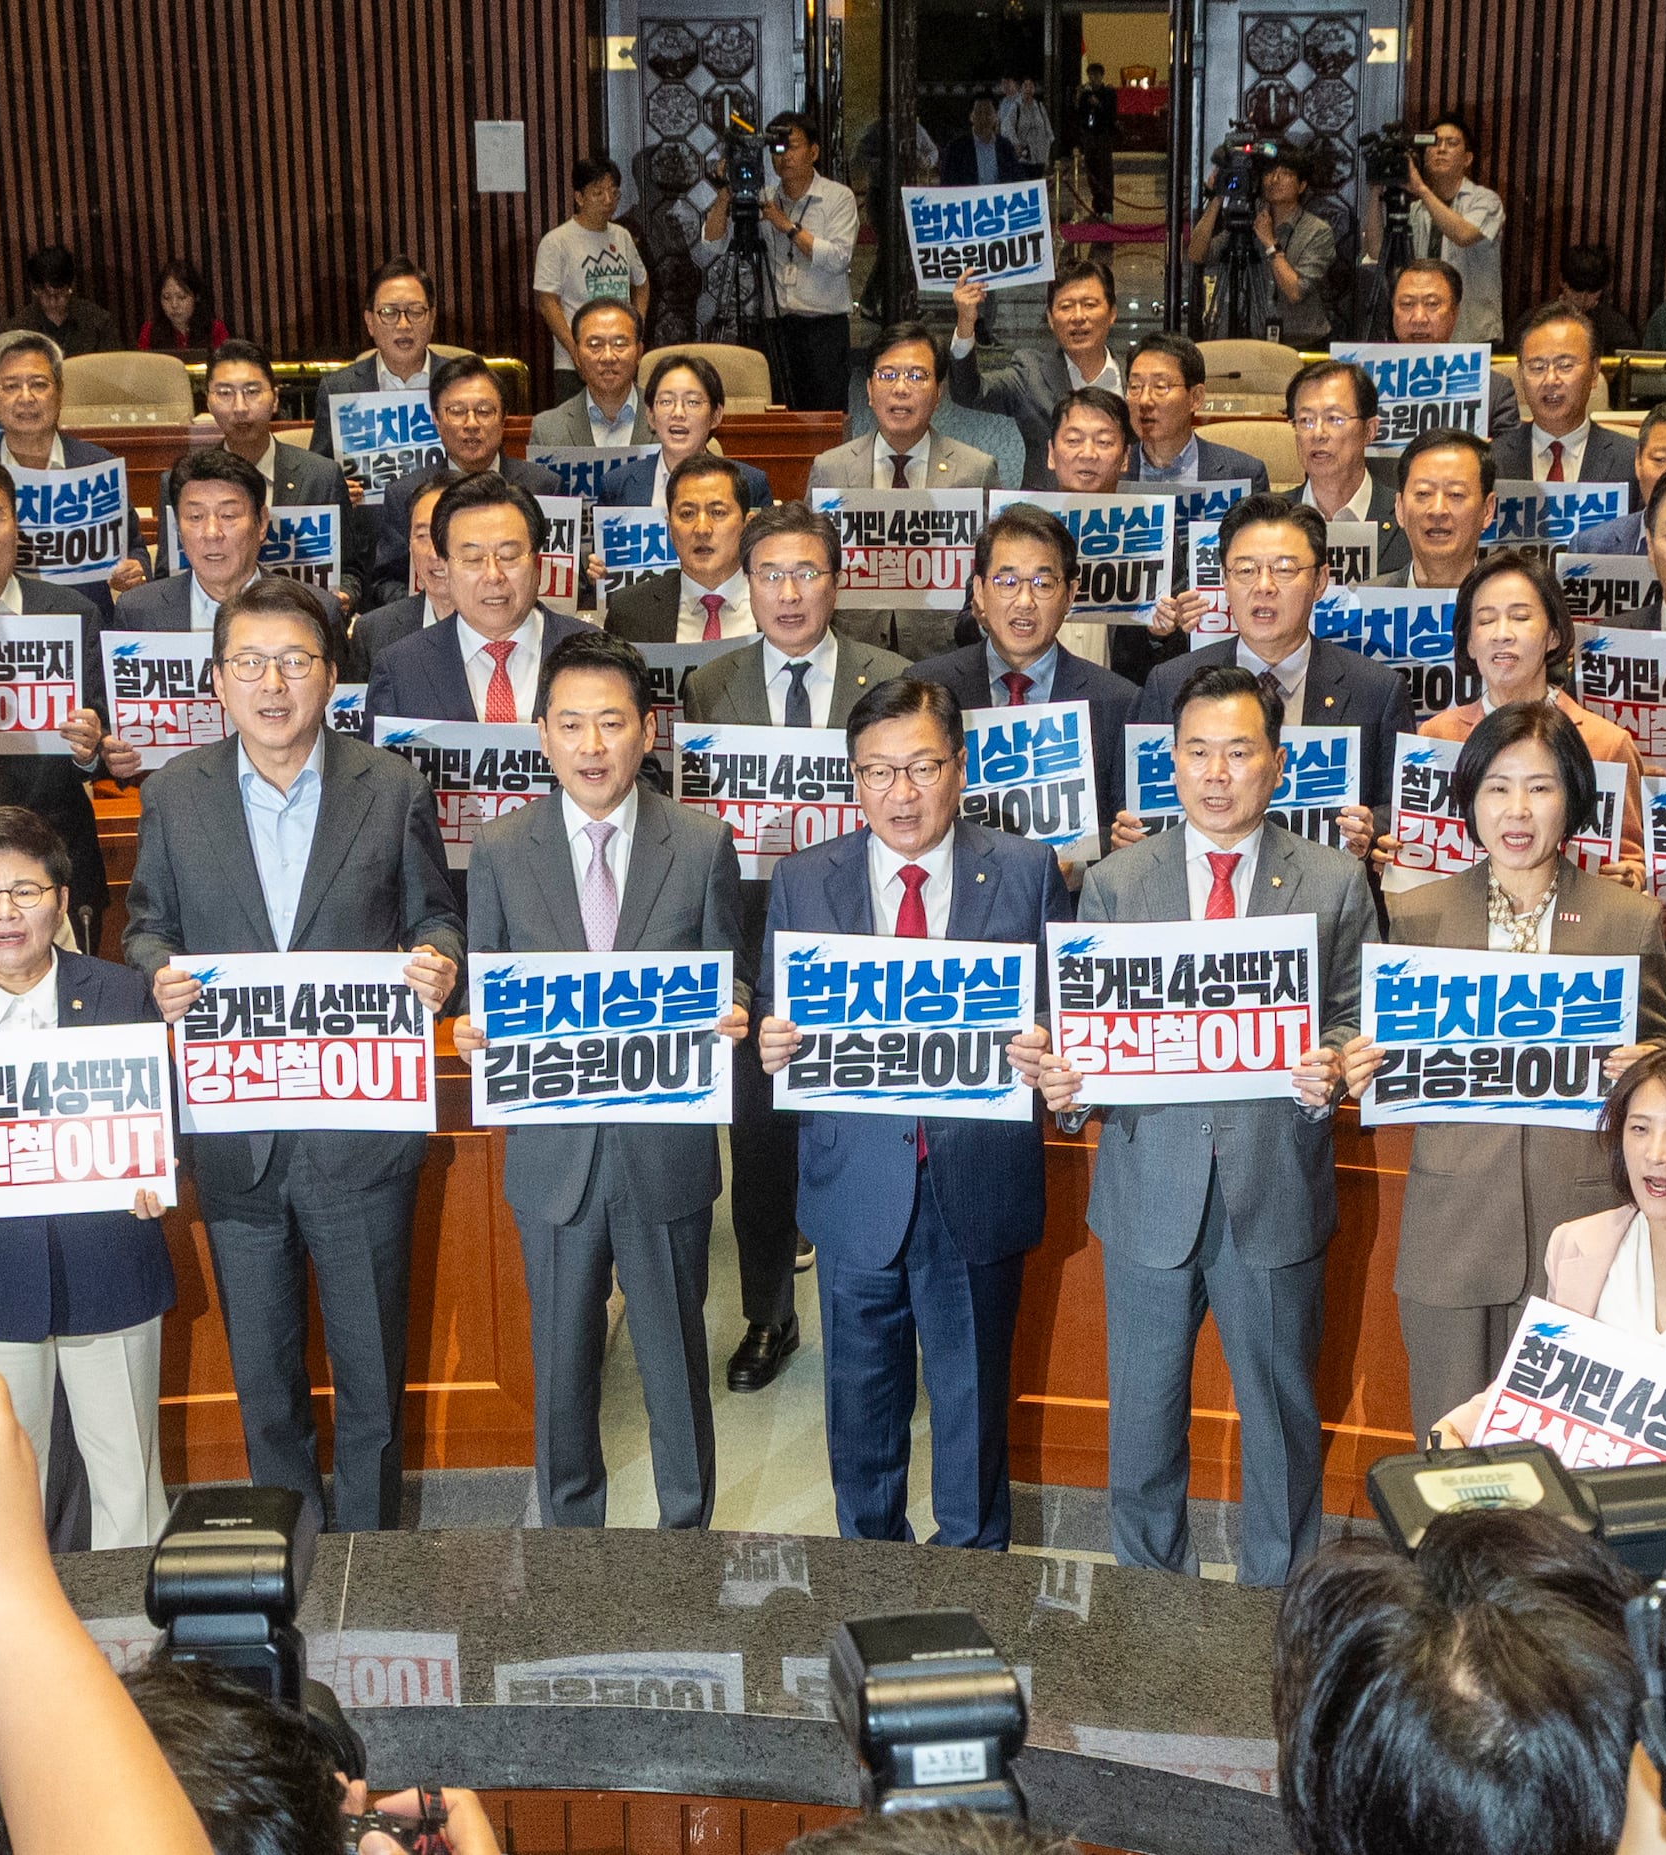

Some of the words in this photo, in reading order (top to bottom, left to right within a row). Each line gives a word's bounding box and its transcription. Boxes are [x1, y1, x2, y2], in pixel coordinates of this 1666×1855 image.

[912, 189, 1041, 244] 법치상실
[916, 231, 1044, 279] 김승원OUT
[339, 402, 439, 451] 법치상
[343, 450, 445, 497] 김승원O
[16, 481, 122, 526] 치상실
[835, 511, 886, 546] 거민
[888, 510, 977, 547] 4성딱지
[1066, 504, 1163, 555] 상실
[1175, 487, 1243, 527] 상실
[1488, 490, 1618, 545] 치상실
[17, 520, 123, 568] 승원OUT
[258, 515, 331, 566] 상실
[603, 524, 680, 568] 법치
[1078, 560, 1163, 602] OUT
[1314, 604, 1454, 660] 법치상
[113, 657, 196, 700] 철거민
[1581, 655, 1659, 702] 철거민
[115, 701, 226, 747] 강신철
[965, 712, 1079, 783] 상실
[473, 746, 556, 792] 4성딱
[681, 754, 766, 799] 철거민
[769, 754, 854, 802] 4성딱
[1401, 763, 1459, 815] 철거
[969, 777, 1086, 836] 원OUT
[483, 962, 720, 1040] 법치상실
[789, 956, 1021, 1027] 법치상실
[1058, 956, 1163, 1011] 철거민
[1168, 947, 1309, 1010] 4성딱지
[1374, 967, 1623, 1043] 법치상실
[184, 985, 288, 1040] 철거민
[290, 982, 423, 1037] 4성딱지
[788, 1029, 1025, 1091] 김승원OUT
[1061, 1006, 1309, 1074] 강신철OUT
[20, 1057, 161, 1113] 4성딱지
[187, 1042, 425, 1103] 강신철OUT
[484, 1031, 720, 1104] 김승원OUT
[1375, 1045, 1608, 1104] 김승원OUT
[1507, 1334, 1624, 1427] 철거민
